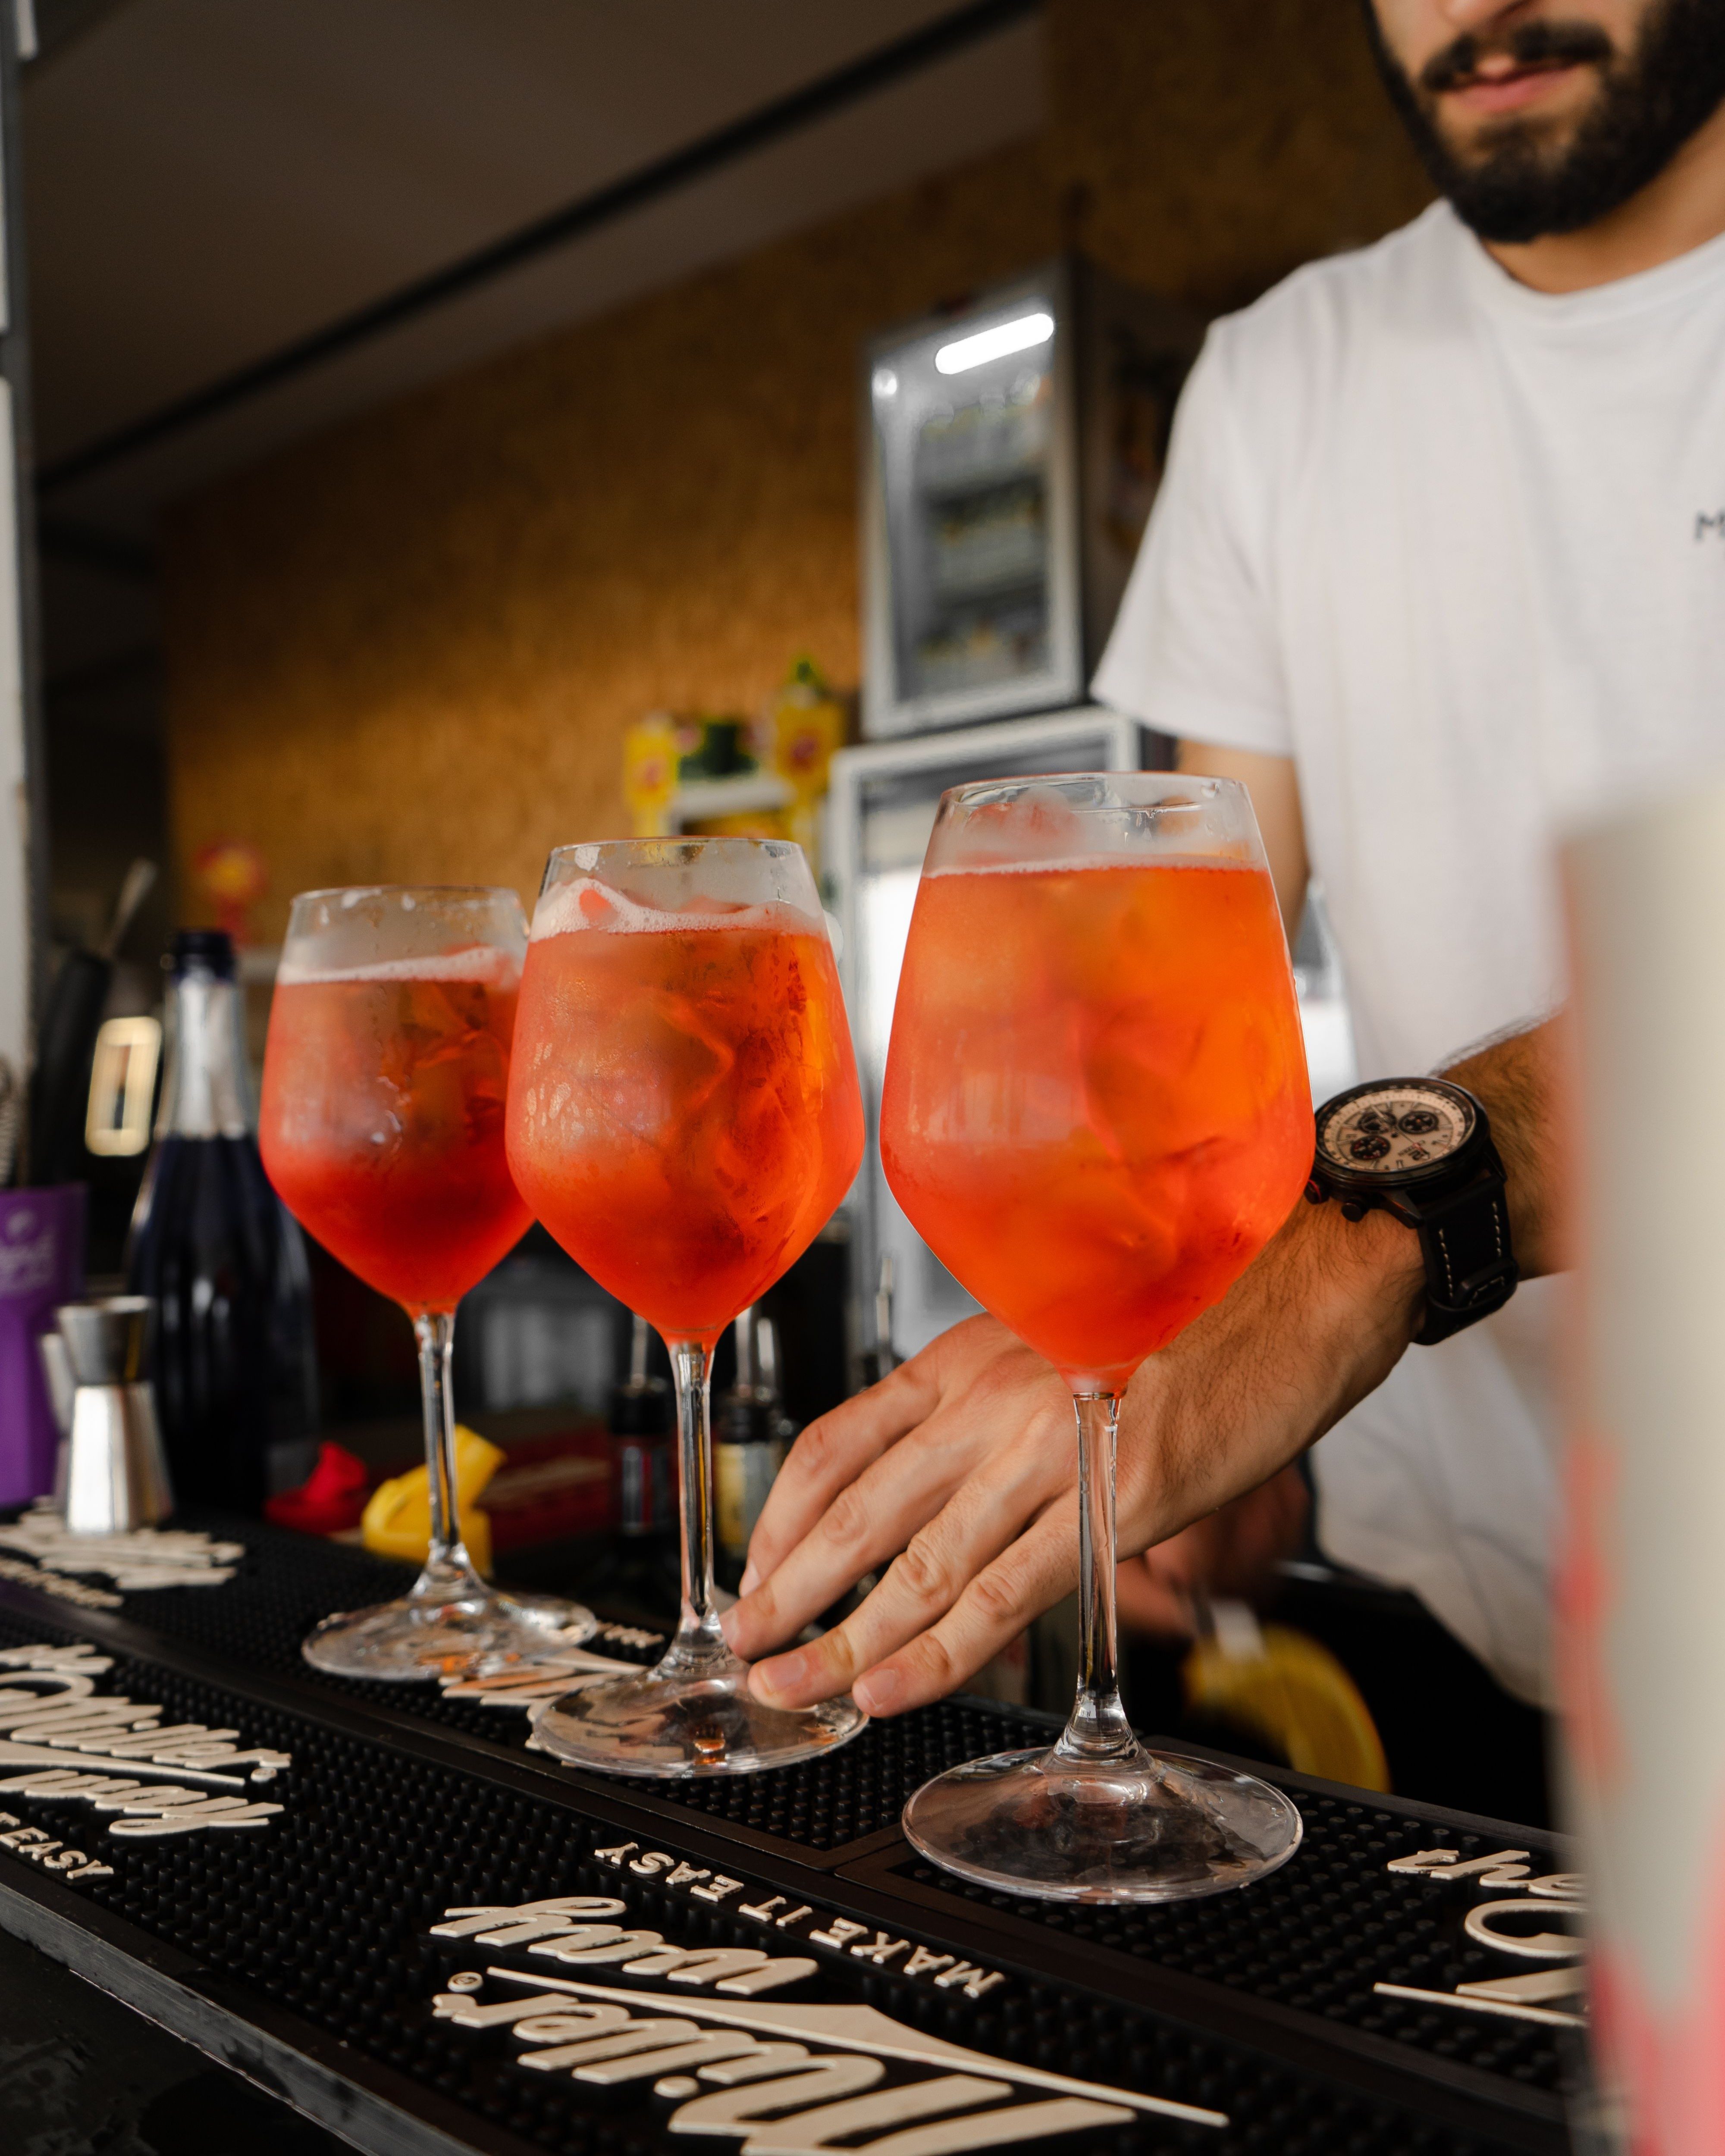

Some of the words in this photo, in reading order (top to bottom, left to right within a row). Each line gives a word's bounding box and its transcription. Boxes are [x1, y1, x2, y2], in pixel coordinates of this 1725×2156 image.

[0, 1827, 114, 1880] EASY
[594, 1842, 745, 1902] EASY
[738, 1896, 813, 1927] IT
[430, 1896, 819, 1995] way
[809, 1917, 1005, 1999] MAKE
